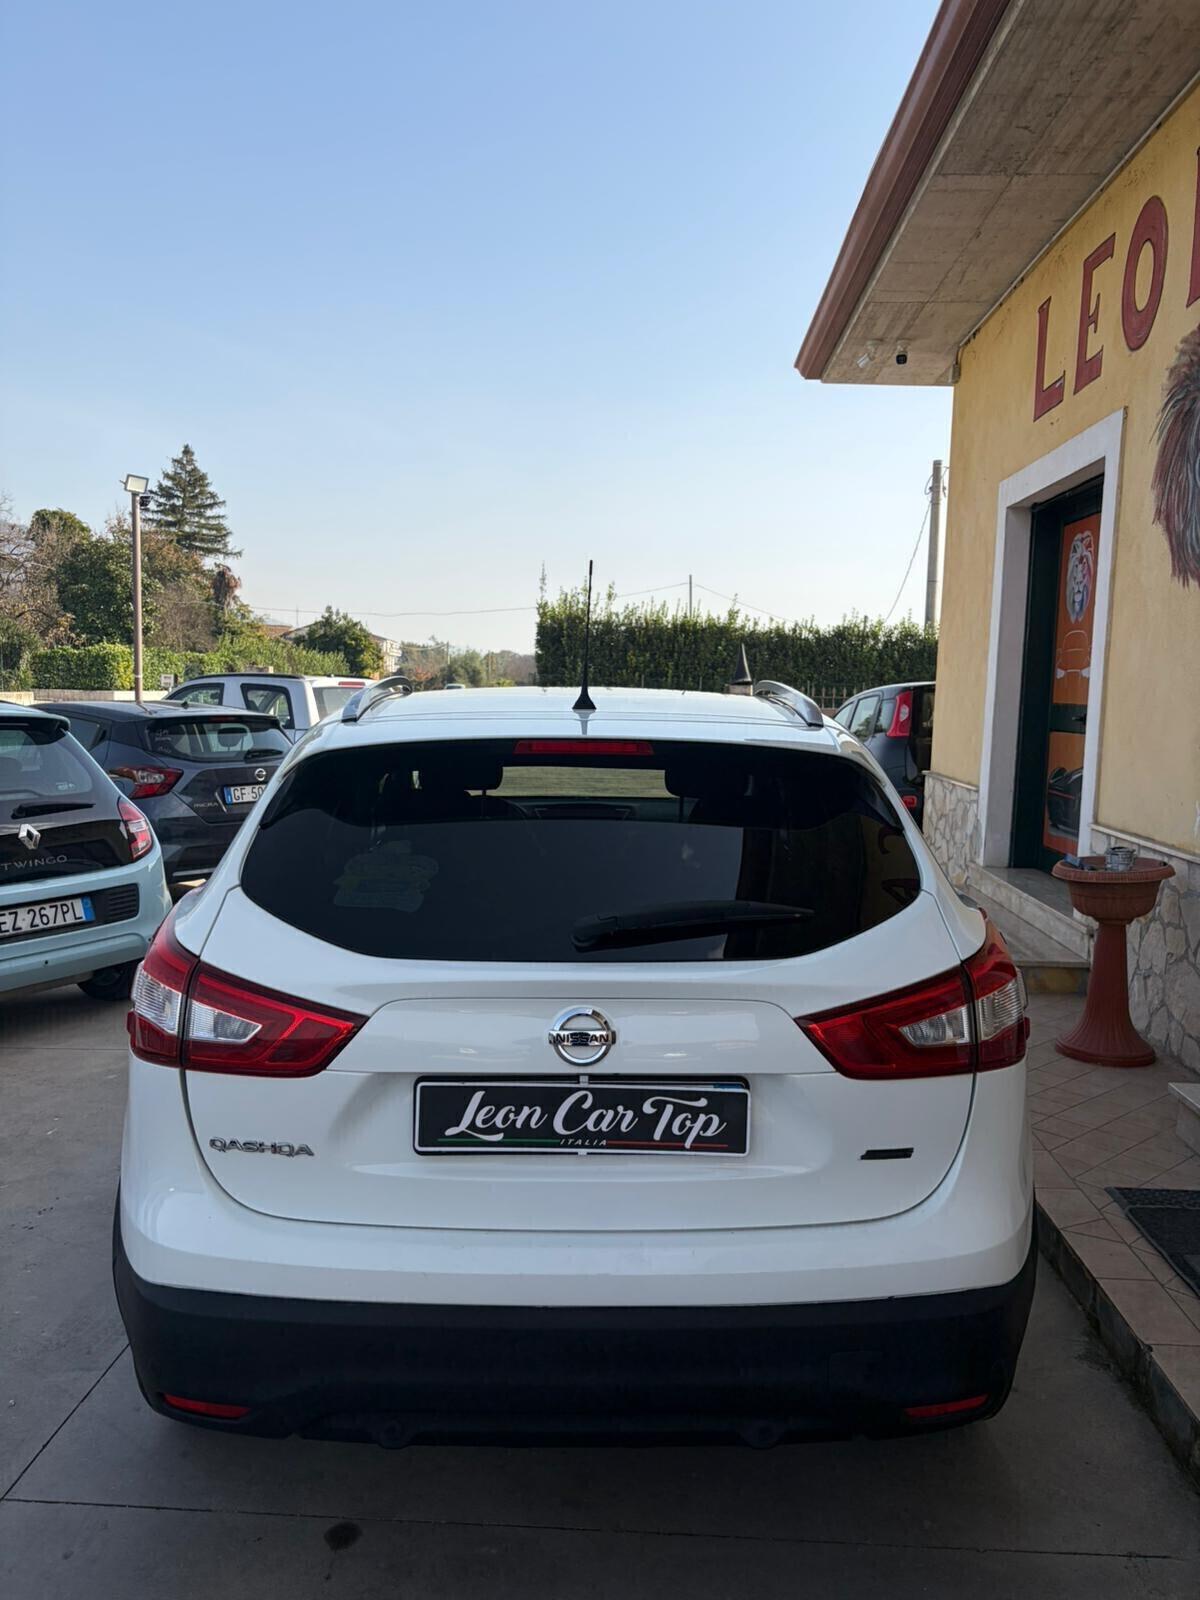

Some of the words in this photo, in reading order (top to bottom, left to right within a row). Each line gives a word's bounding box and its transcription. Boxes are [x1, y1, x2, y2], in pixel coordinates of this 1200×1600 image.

[1033, 146, 1200, 422] LEO
[233, 787, 246, 801] GF
[1, 855, 67, 871] TWINGO
[0, 911, 22, 934] EZ
[27, 901, 84, 929] 267PL
[555, 1031, 609, 1045] NISSAN
[445, 1090, 548, 1142] Leon
[552, 1090, 640, 1136] Car
[642, 1096, 728, 1149] Top
[560, 1138, 607, 1146] ITALIA
